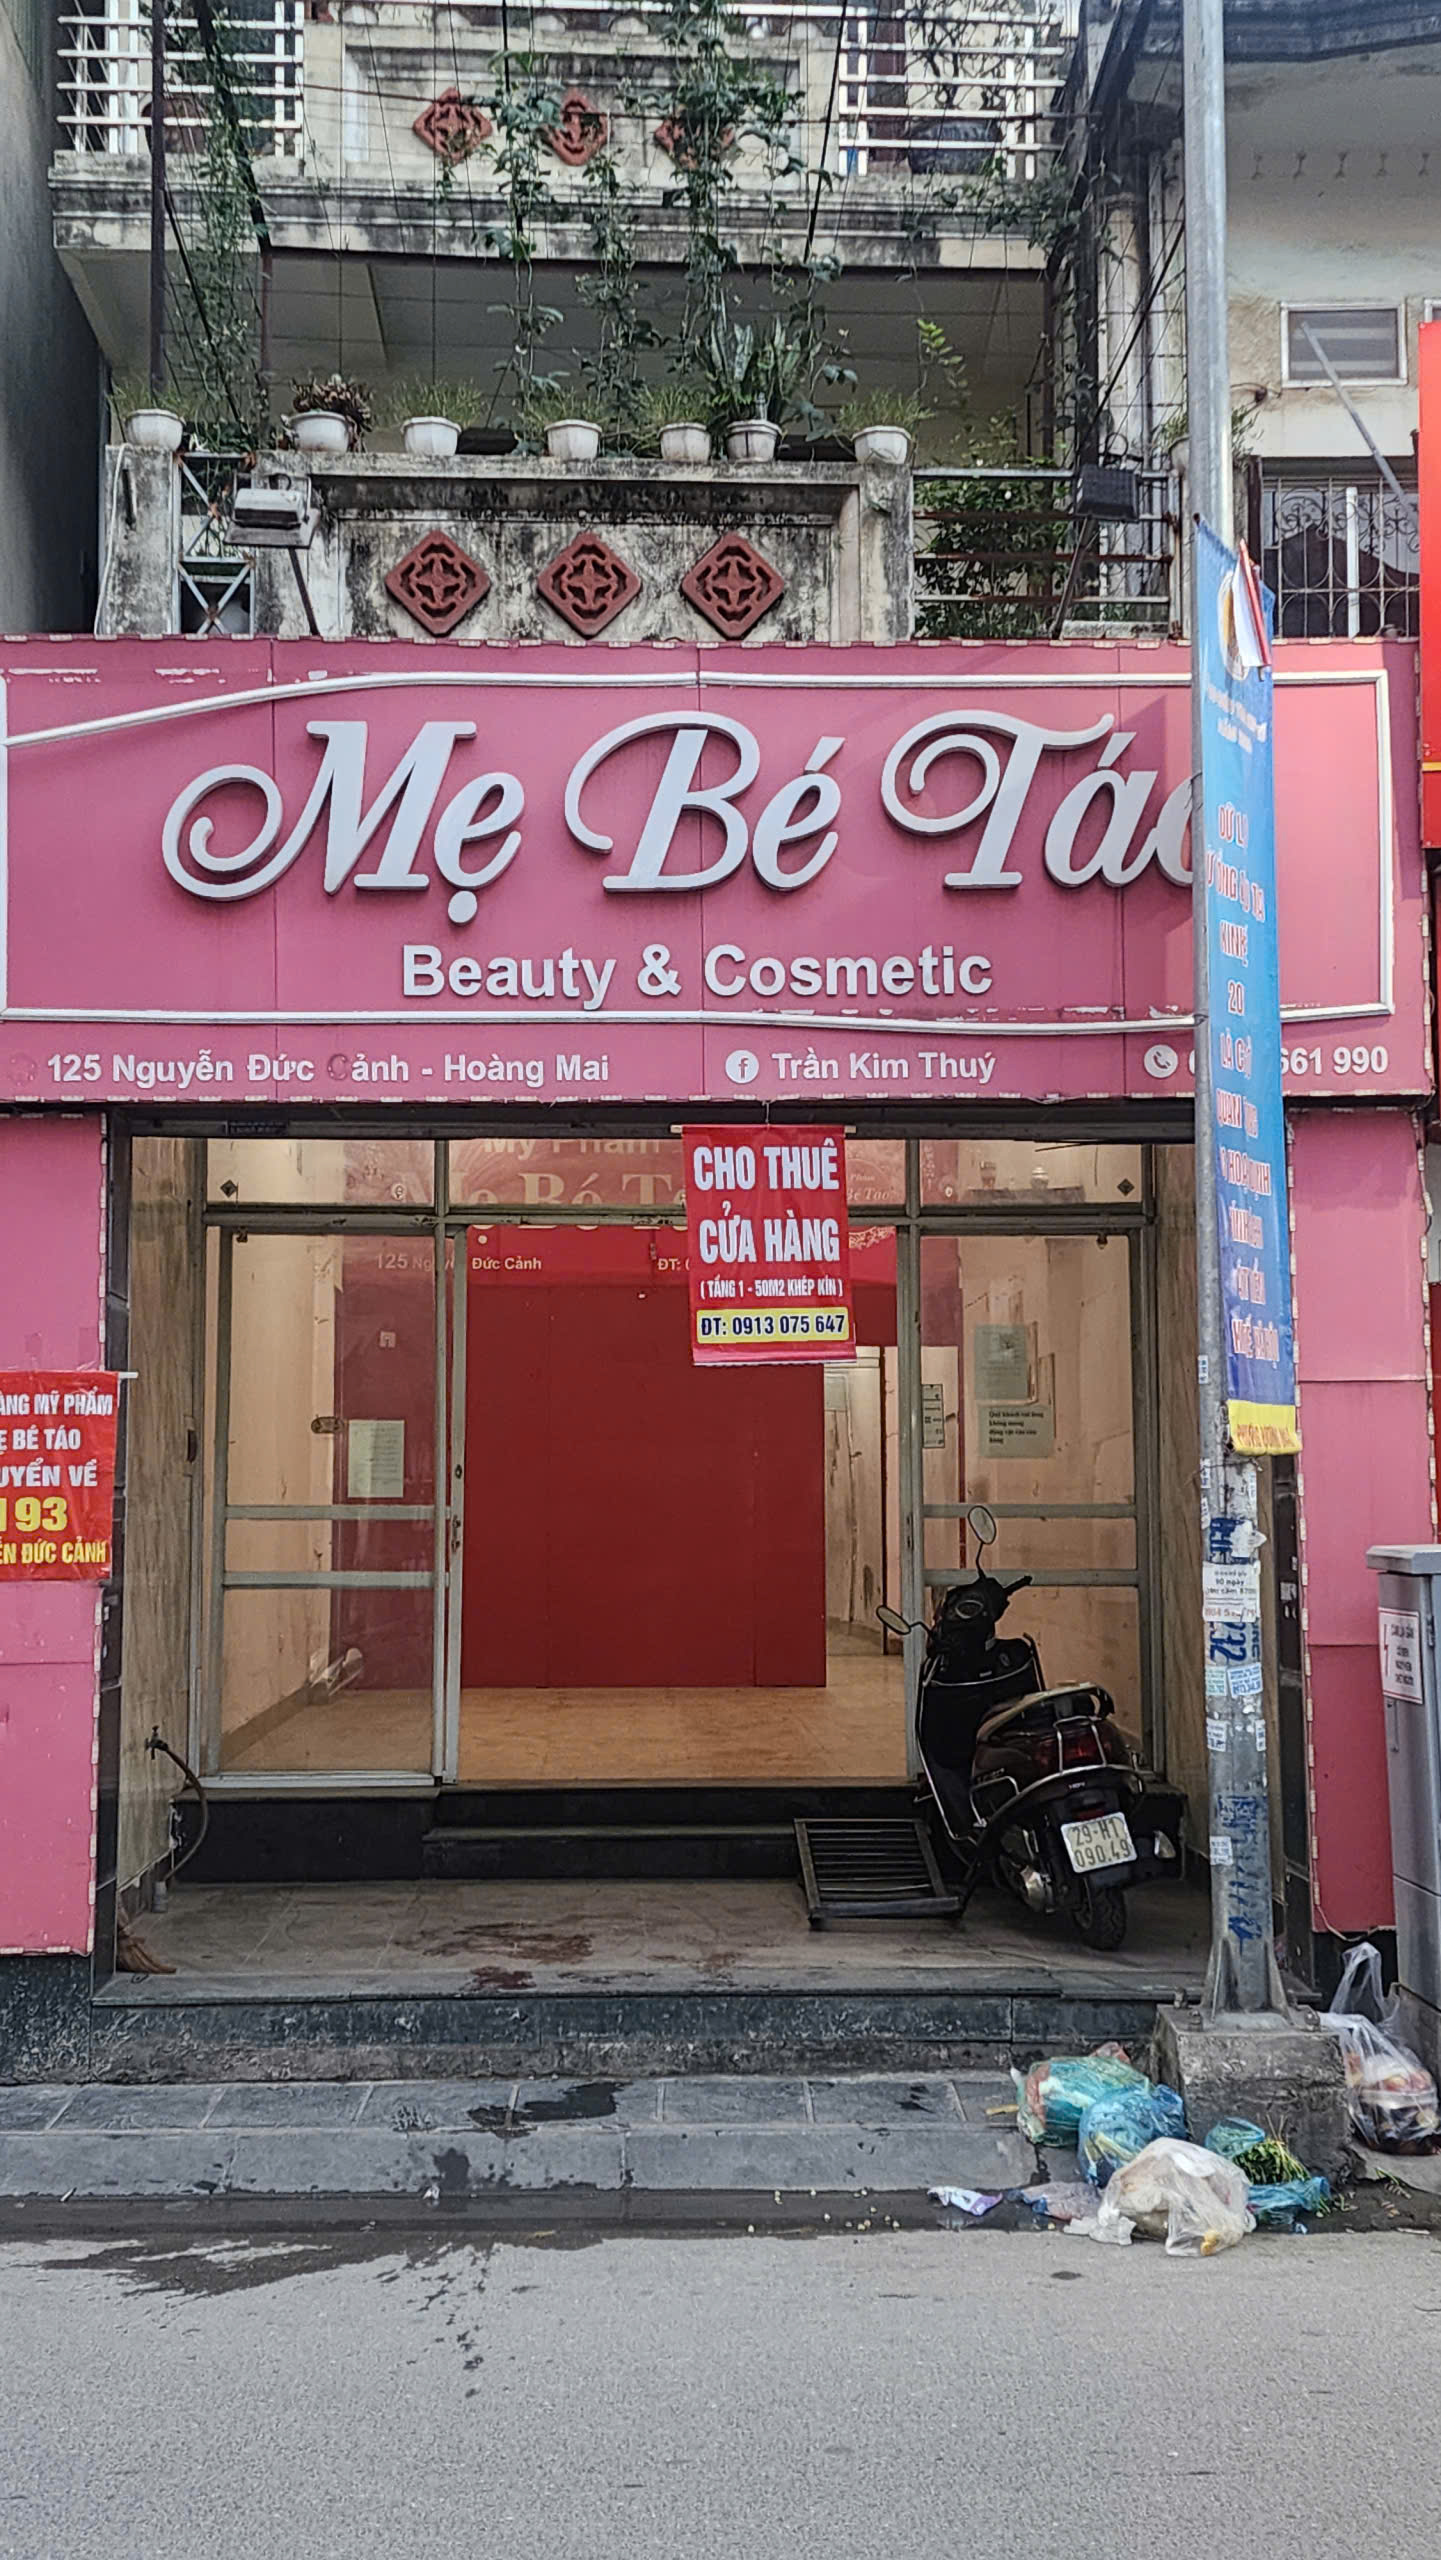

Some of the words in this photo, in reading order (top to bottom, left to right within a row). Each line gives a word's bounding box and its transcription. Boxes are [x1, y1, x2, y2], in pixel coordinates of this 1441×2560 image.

[162, 720, 525, 925] Mẹ
[564, 710, 842, 892] Bé
[403, 943, 617, 1011] Beauty
[637, 943, 683, 998] &
[705, 944, 994, 997] Cosmetic
[48, 1054, 102, 1082] 125
[112, 1050, 233, 1089] Nguyễn
[247, 1053, 315, 1082] Đức
[444, 1053, 545, 1088] Hoàng
[556, 1054, 609, 1081] Mai
[772, 1047, 839, 1079] Trần
[850, 1053, 909, 1079] Kim
[918, 1052, 996, 1084] Thuý
[1333, 1045, 1389, 1075] 990
[693, 1146, 756, 1191] CHO
[763, 1137, 840, 1190] THUÊ
[699, 1200, 757, 1264] CỬA
[763, 1209, 840, 1263] HÀNG
[472, 1255, 501, 1270] Đức
[504, 1255, 542, 1270] Cảnh
[738, 1280, 744, 1298] 1
[755, 1279, 786, 1297] 50M2
[787, 1275, 815, 1297] KHÉP
[818, 1274, 837, 1296] KÍN
[701, 1316, 727, 1335] ĐT:
[732, 1316, 774, 1335] 0913
[780, 1315, 810, 1334] 075
[815, 1314, 846, 1334] 647
[34, 1390, 60, 1415] MỸ
[63, 1386, 113, 1416] PHẨM
[12, 1424, 39, 1451] BÉ
[43, 1424, 81, 1451] TÁO
[21, 1538, 57, 1564] ĐỨC
[62, 1535, 106, 1564] CẢNH
[1072, 1818, 1119, 1846] 29-H1
[1074, 1840, 1131, 1867] 090.49
